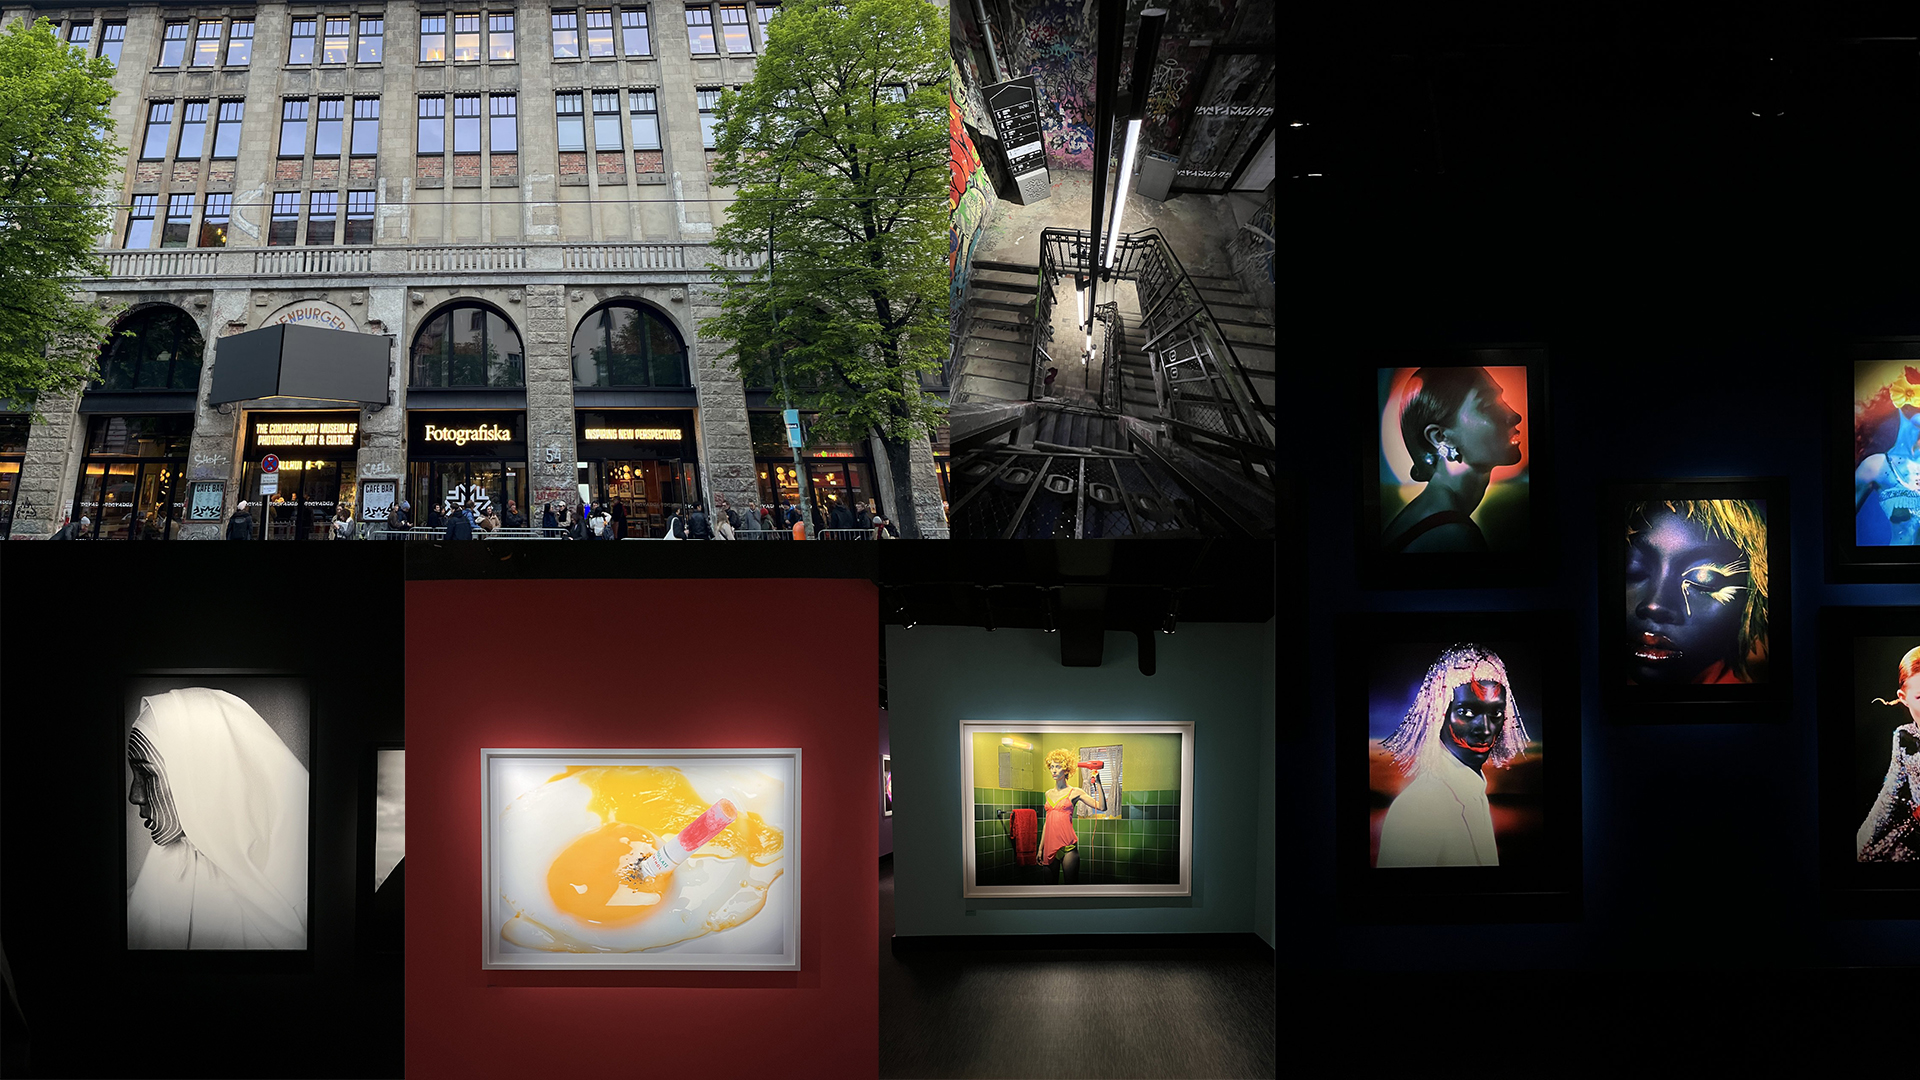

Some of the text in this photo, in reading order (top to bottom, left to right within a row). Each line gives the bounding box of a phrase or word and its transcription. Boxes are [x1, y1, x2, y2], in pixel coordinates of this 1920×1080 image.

[274, 307, 346, 331] ENBURGER
[256, 423, 358, 434] THE CONTEMPORARY MUSEUM OF
[424, 423, 512, 446] Fotografiska
[584, 428, 682, 440] INSPIRING NEW PERSPECTIVES
[257, 434, 354, 446] PHOTOGRAPHY, ART & CULTURE
[546, 447, 562, 463] 54
[211, 483, 225, 493] BAR
[381, 484, 394, 493] BAR
